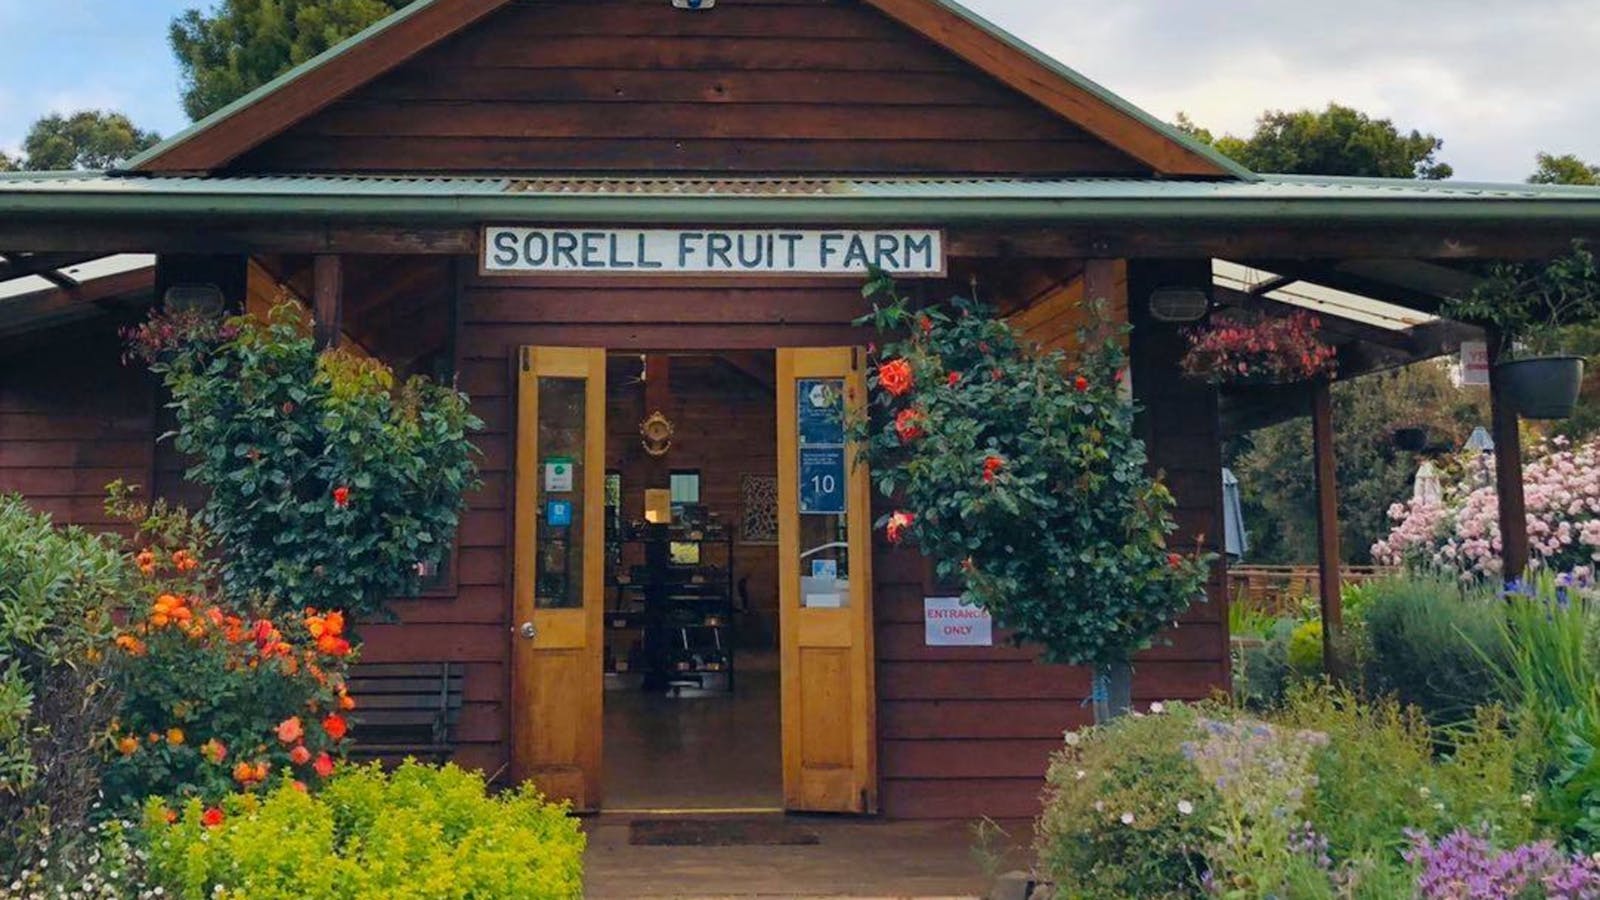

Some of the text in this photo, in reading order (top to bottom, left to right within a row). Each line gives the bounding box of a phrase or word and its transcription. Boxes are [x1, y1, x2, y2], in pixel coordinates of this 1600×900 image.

[493, 231, 932, 270] SORELL FRUIT FARM
[811, 475, 835, 493] 10
[943, 626, 973, 635] ONLY
